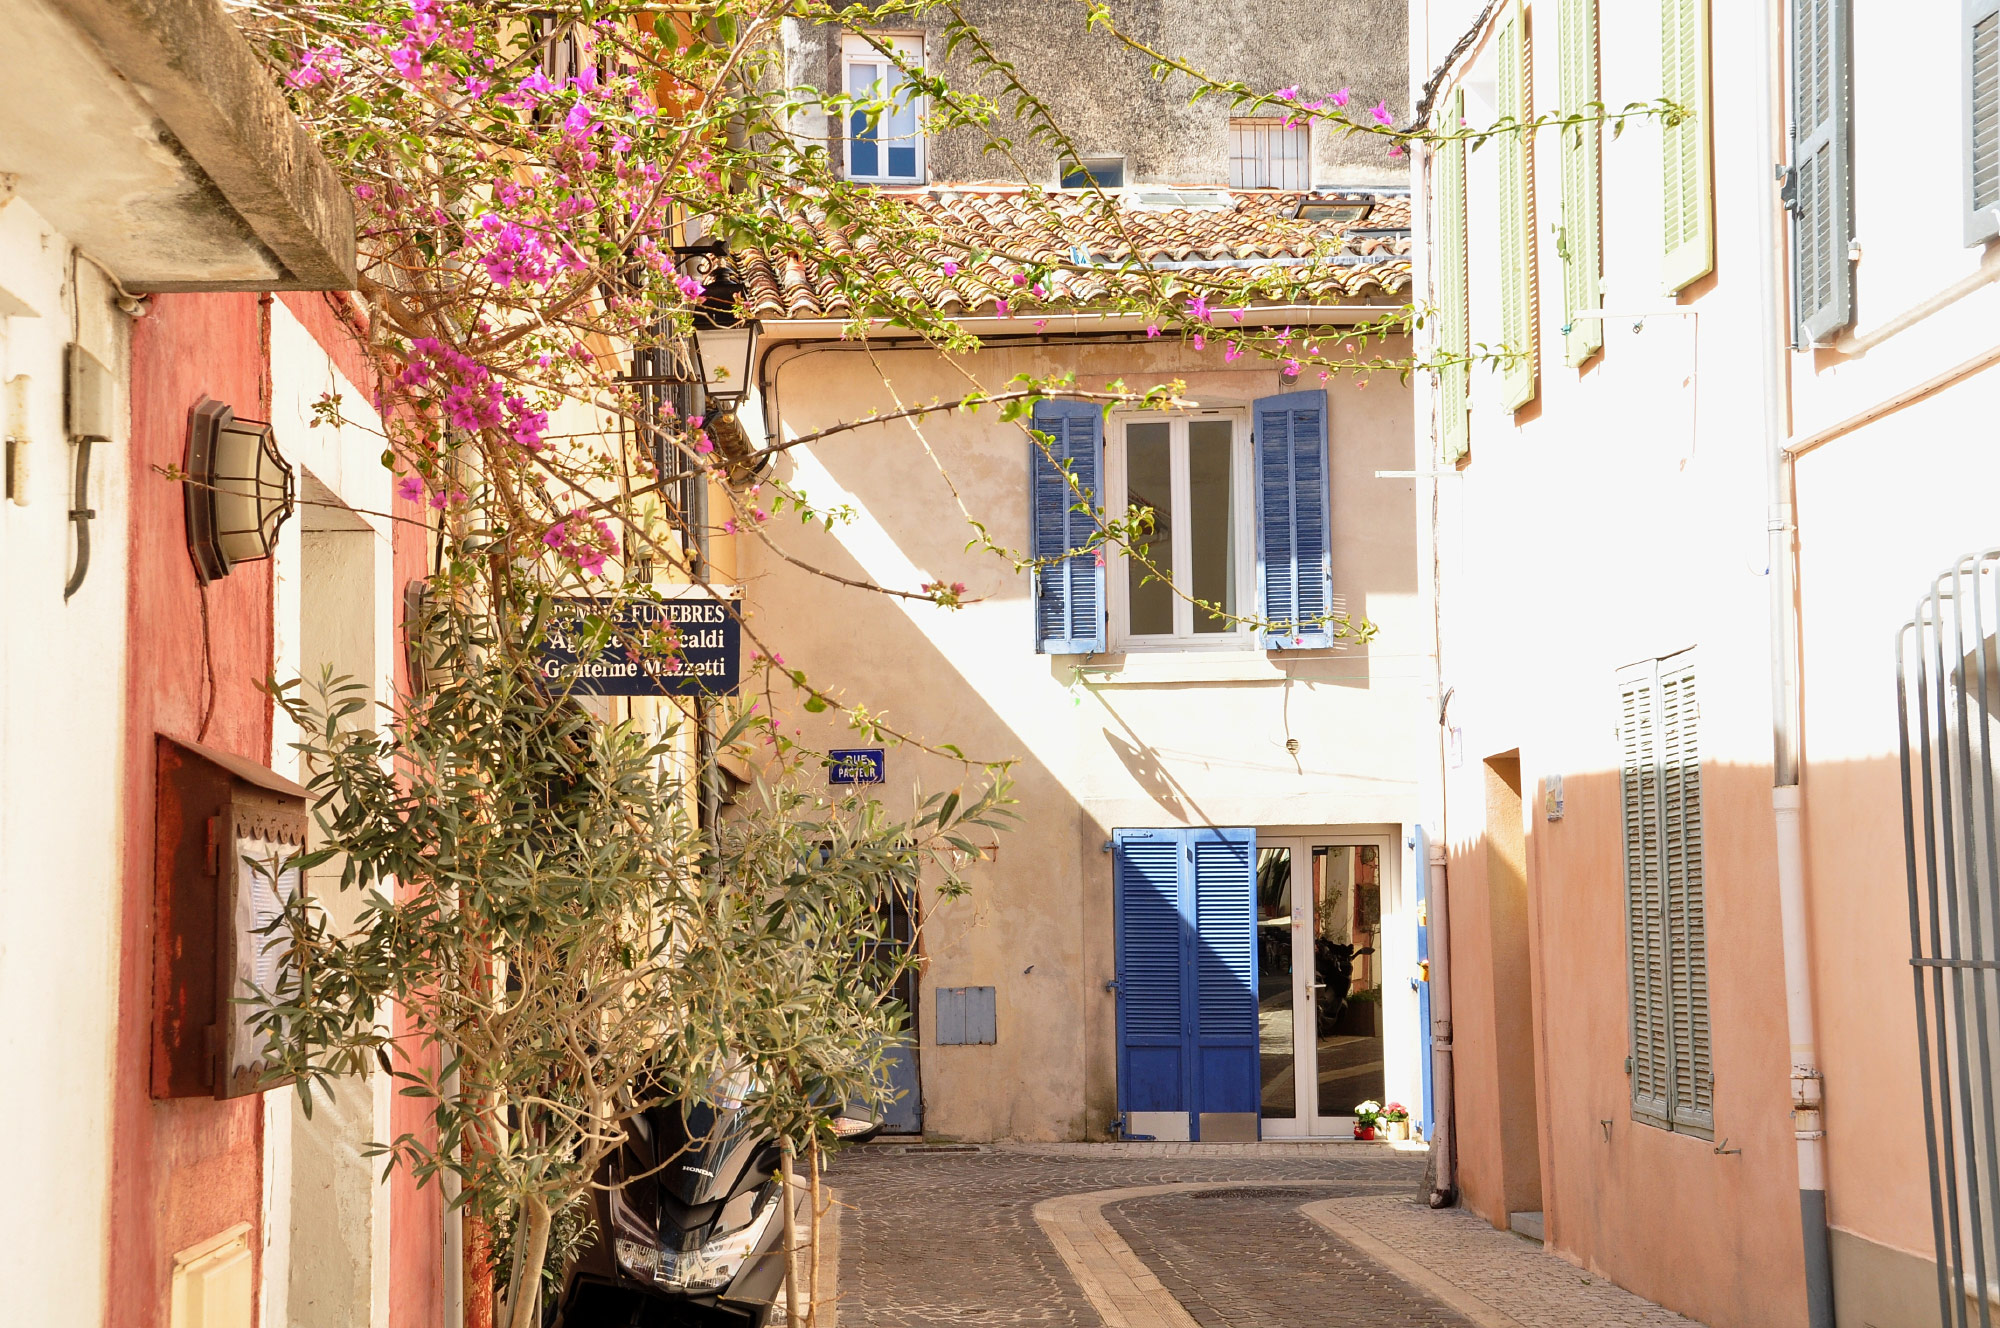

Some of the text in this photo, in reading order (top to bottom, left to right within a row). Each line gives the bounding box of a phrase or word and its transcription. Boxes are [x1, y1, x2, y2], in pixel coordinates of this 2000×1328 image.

[631, 604, 725, 623] FUNEBRES
[549, 628, 623, 653] Agce
[846, 754, 868, 766] RUE
[682, 1165, 714, 1178] HONDA
